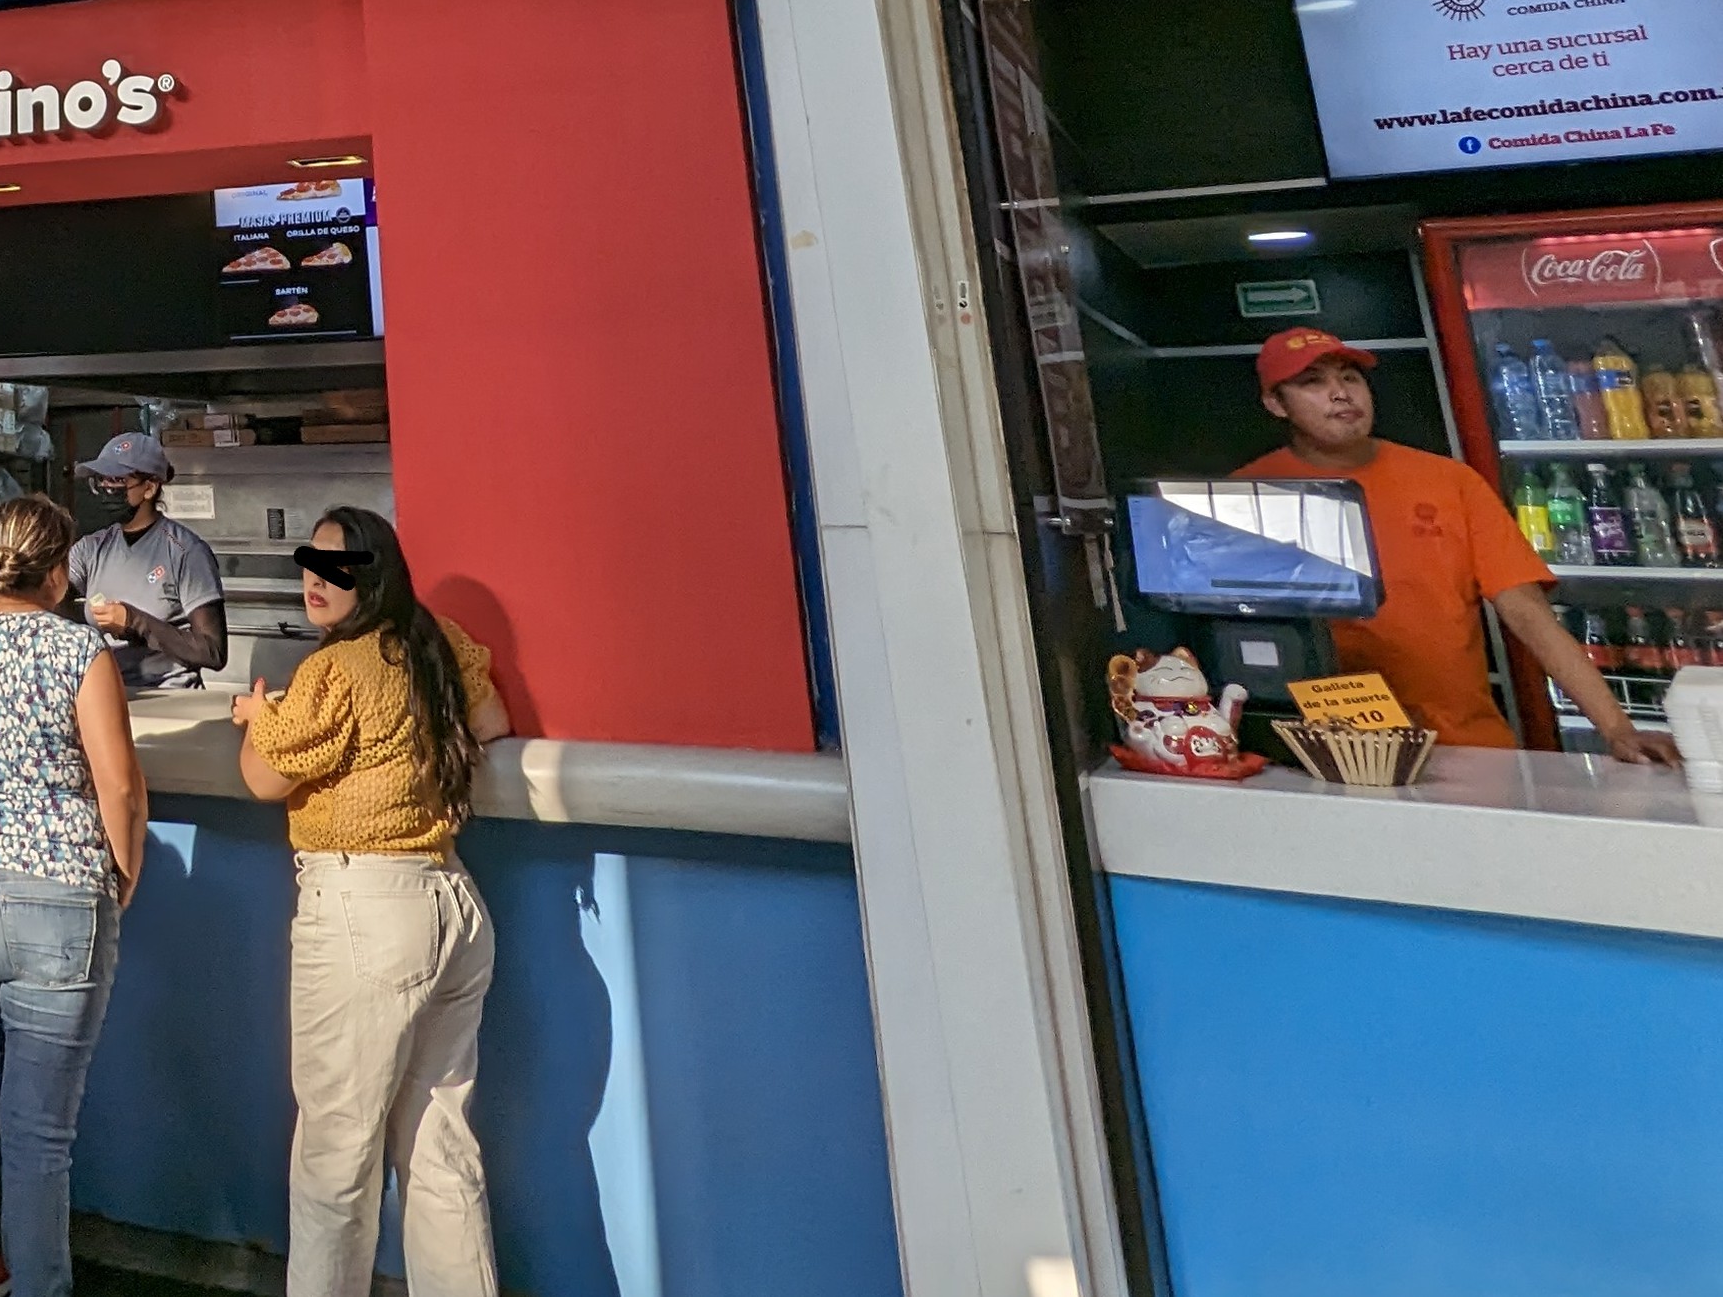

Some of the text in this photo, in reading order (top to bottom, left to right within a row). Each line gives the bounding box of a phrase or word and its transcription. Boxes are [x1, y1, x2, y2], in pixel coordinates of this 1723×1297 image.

[1507, 0, 1570, 16] COMIDA
[1447, 24, 1649, 61] Hay una sucursal
[1493, 50, 1610, 78] cerca de ti
[1374, 86, 1723, 130] www.lafecomidachina.com.
[1488, 123, 1676, 150] Comida China La Fe
[239, 209, 333, 228] MASAS PREMIUM
[233, 225, 360, 242] ITALIANA ORILLA DE QUESO
[1532, 249, 1648, 284] Coca-Cola
[275, 286, 309, 296] SARTÉN
[1311, 680, 1366, 694] Galleta
[1303, 692, 1391, 710] de la suerte
